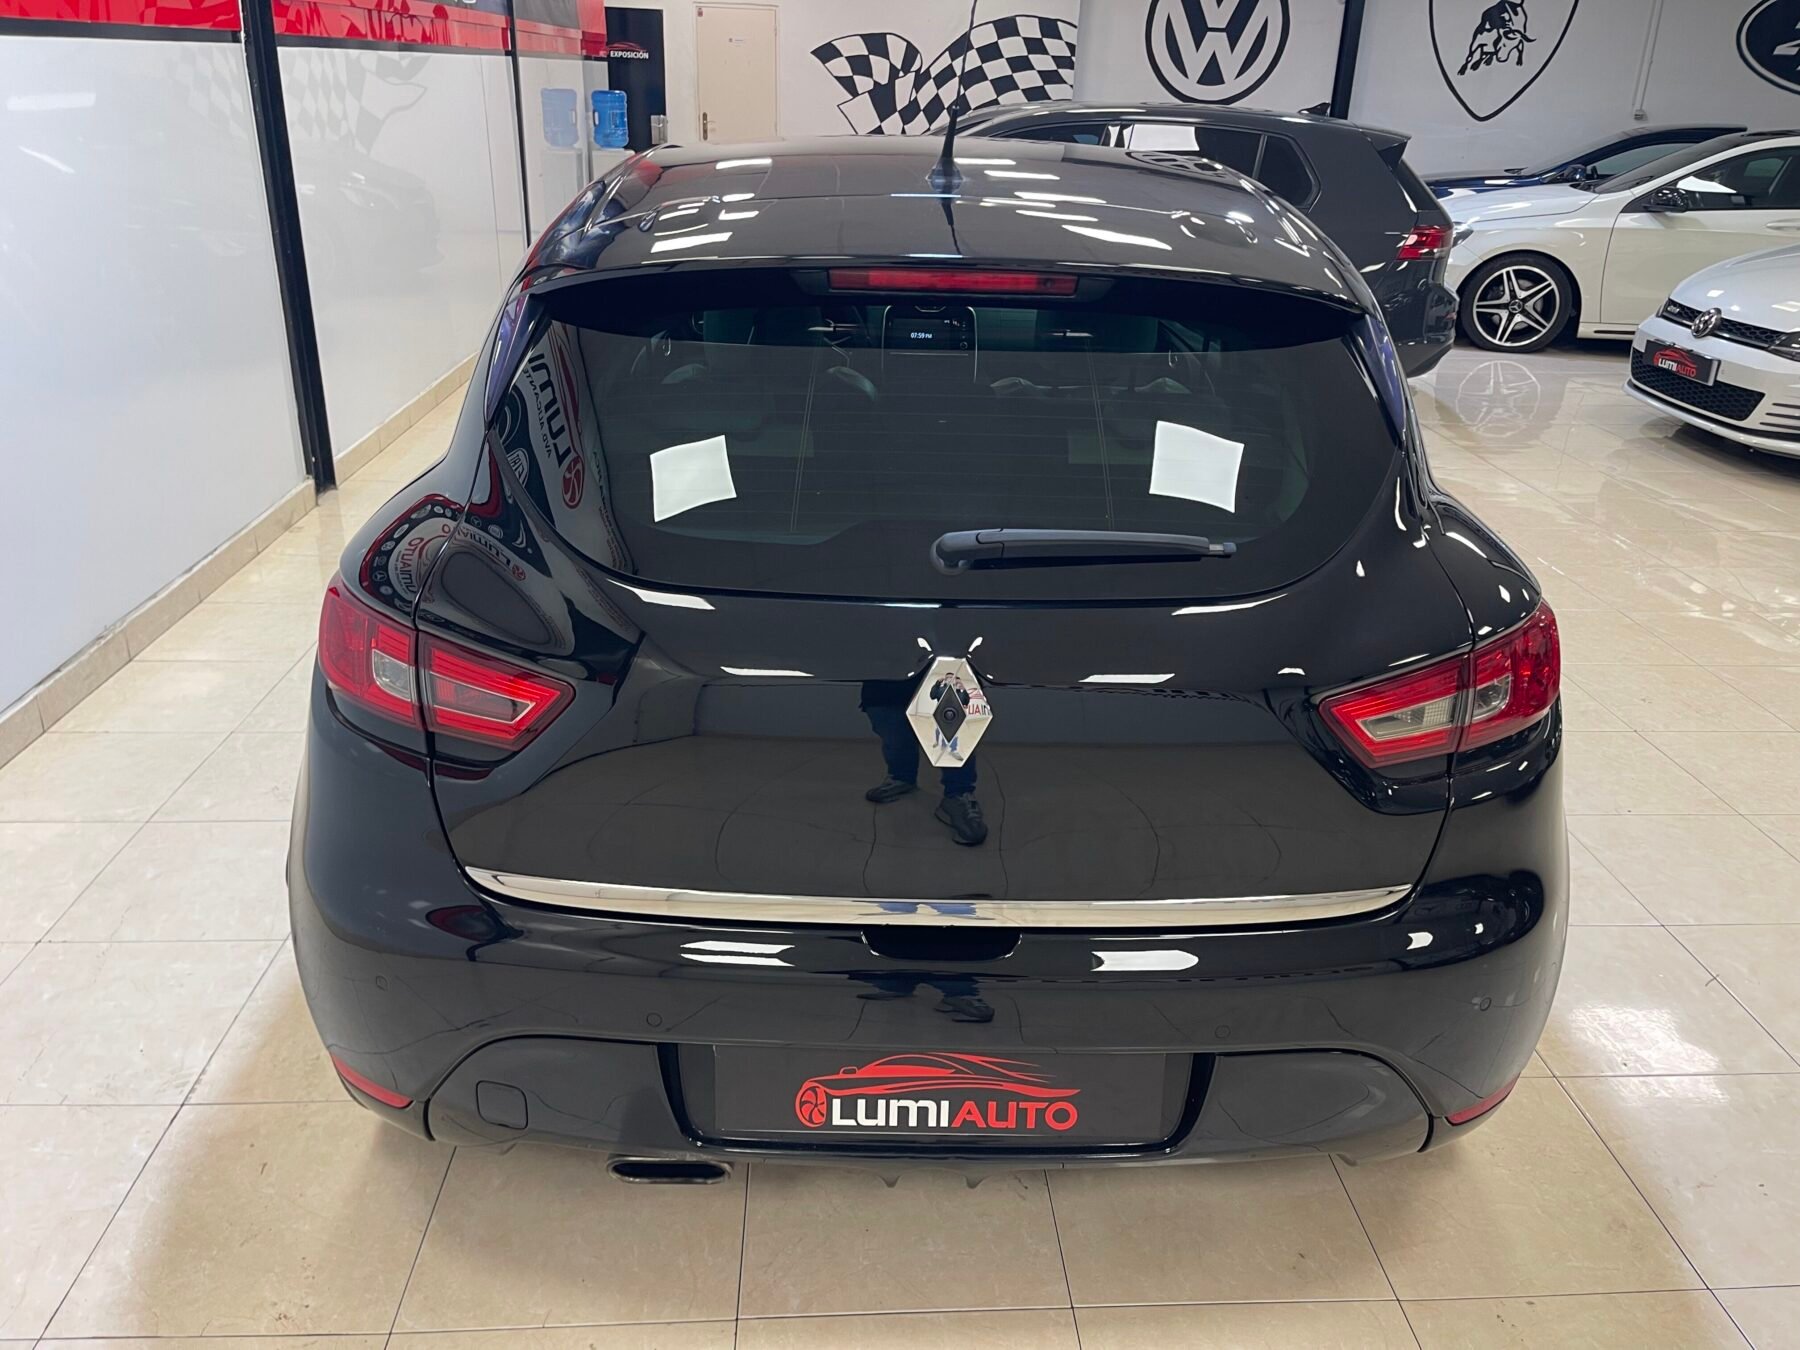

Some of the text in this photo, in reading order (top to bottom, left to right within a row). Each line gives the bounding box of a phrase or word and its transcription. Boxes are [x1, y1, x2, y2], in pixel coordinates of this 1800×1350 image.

[610, 50, 649, 59] EXPOSICIÓN
[1658, 358, 1697, 377] LUMIAUTO
[831, 1098, 1078, 1130] LUMIAUTO
